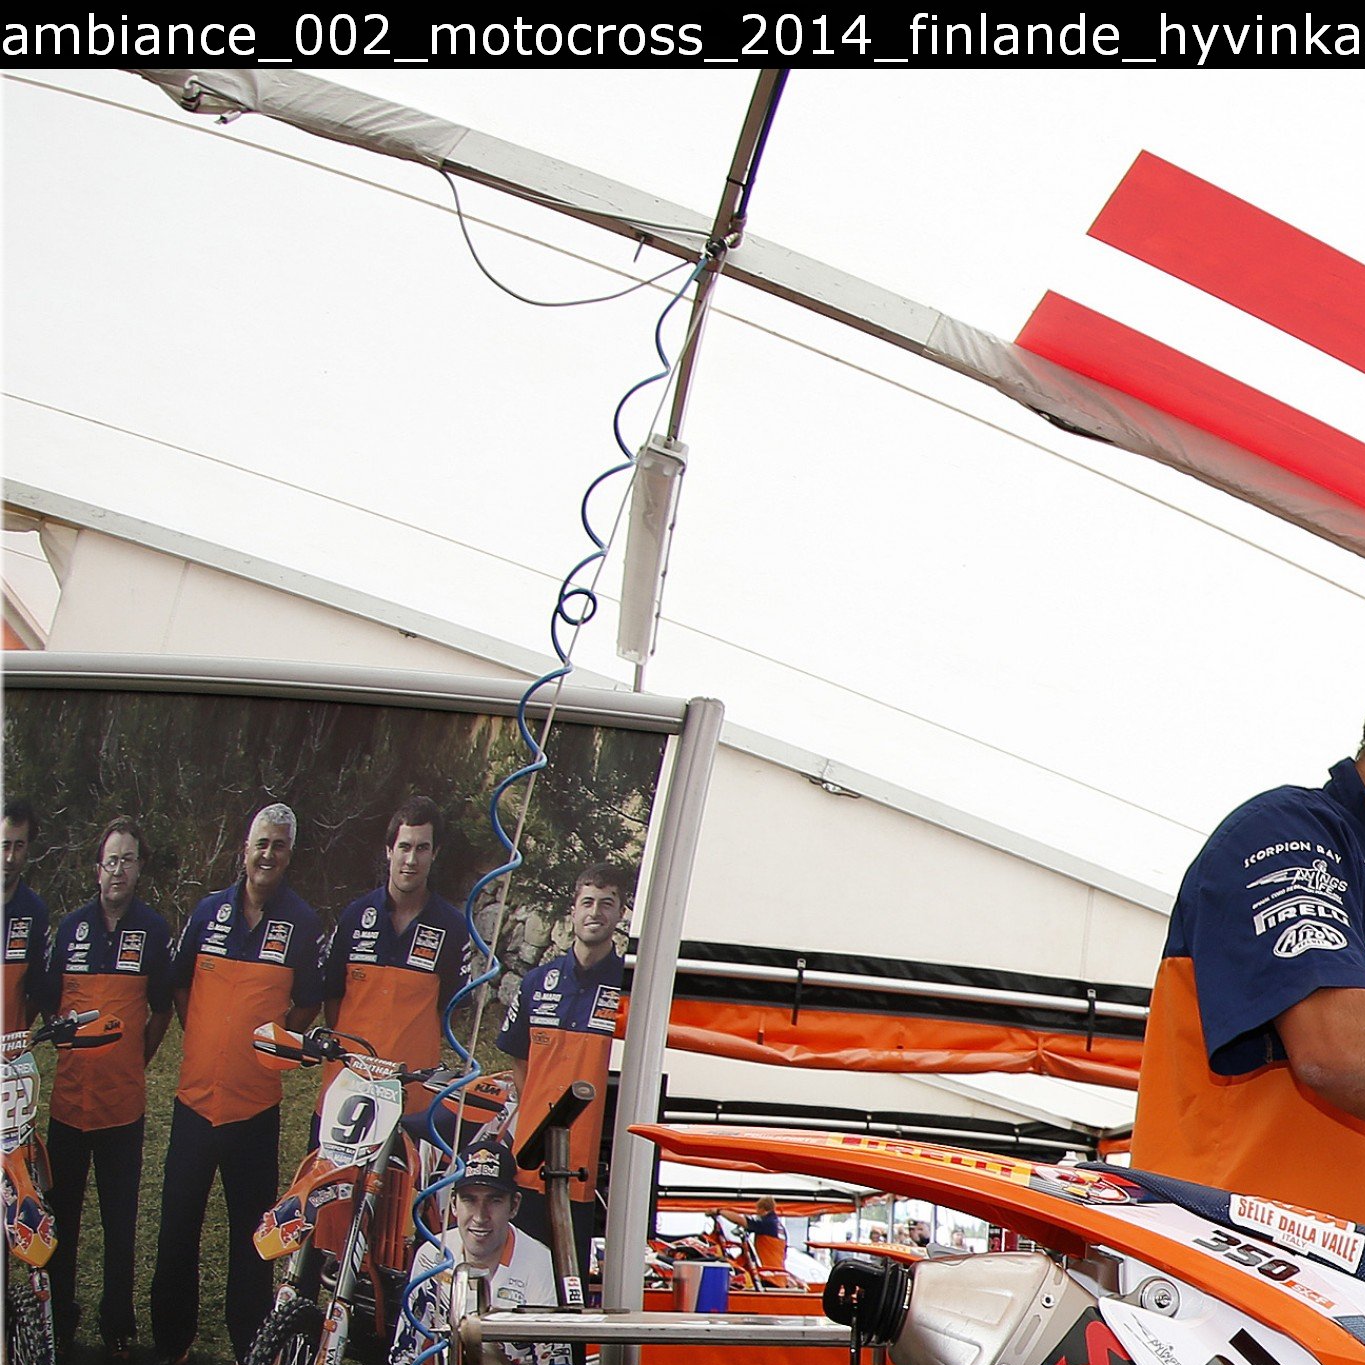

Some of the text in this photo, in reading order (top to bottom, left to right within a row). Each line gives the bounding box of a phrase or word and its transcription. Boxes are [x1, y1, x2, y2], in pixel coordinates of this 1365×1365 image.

[1244, 841, 1342, 868] SCORPION BAY
[1, 1076, 39, 1130] 22
[330, 1094, 377, 1145] 9
[1192, 1229, 1301, 1282] 350
[1238, 1197, 1274, 1226] SELLE
[1278, 1215, 1316, 1244] DALLA
[1322, 1230, 1359, 1263] VALLE
[1281, 1232, 1307, 1248] ITALY
